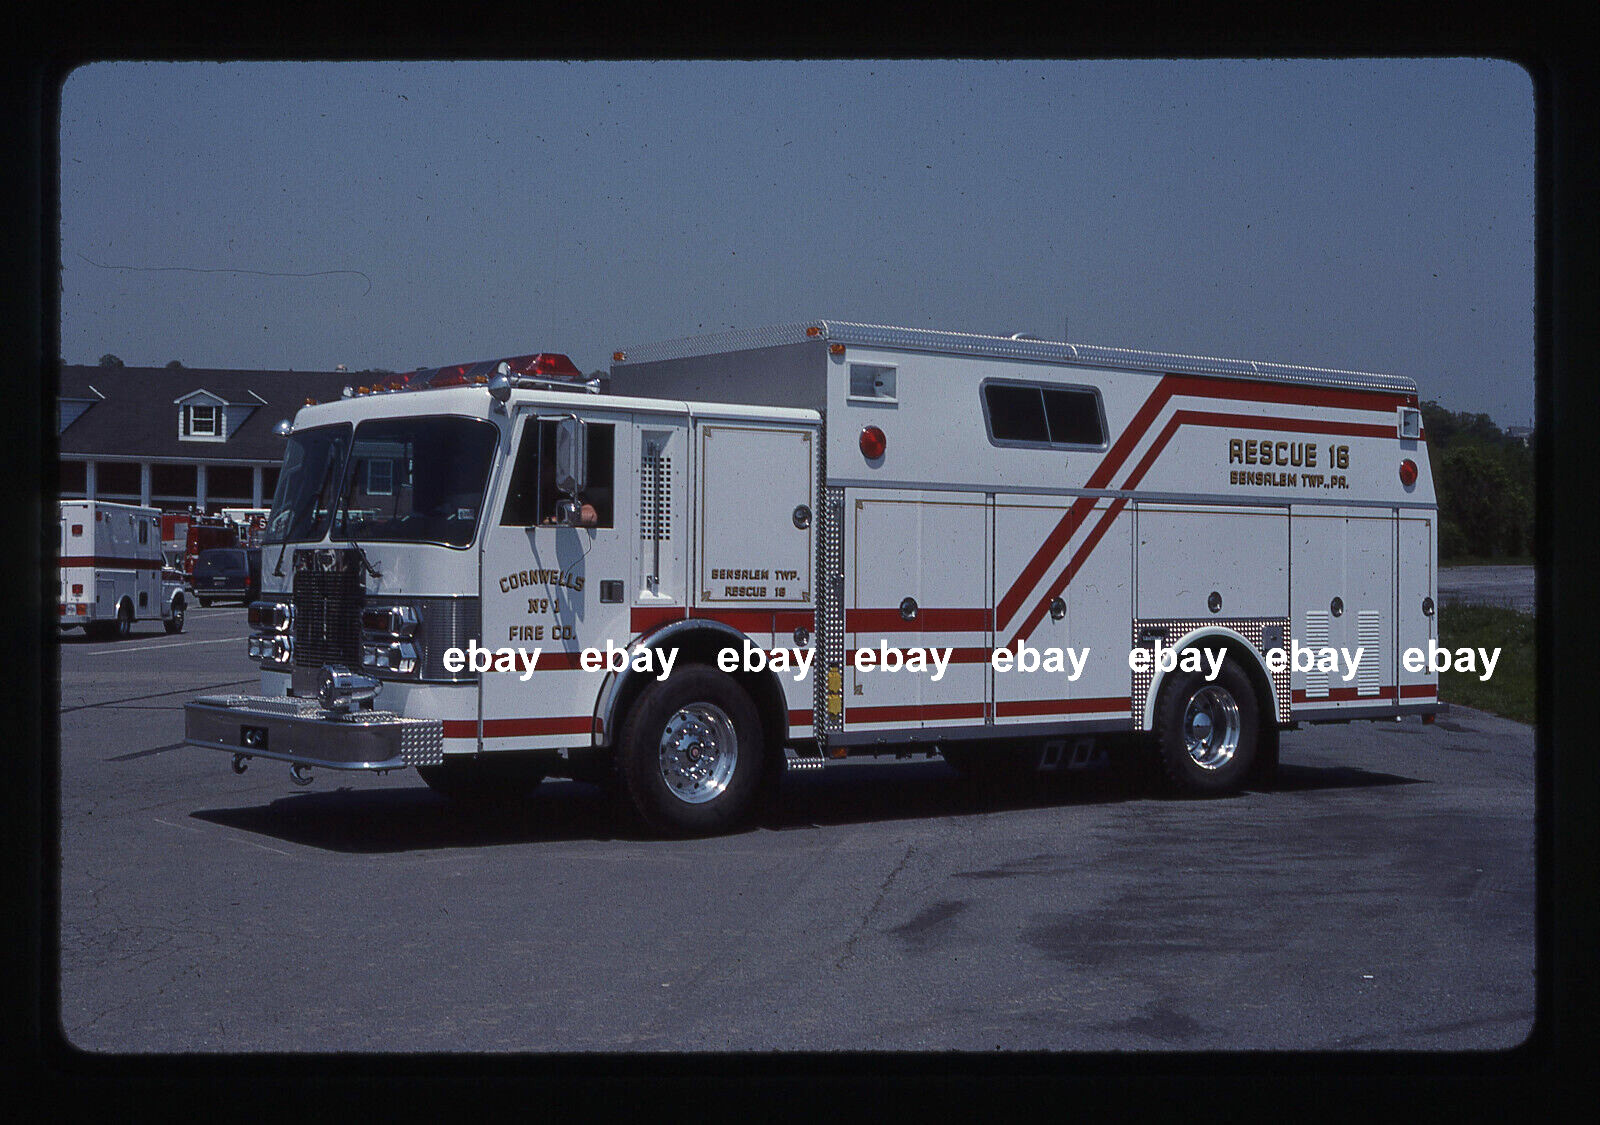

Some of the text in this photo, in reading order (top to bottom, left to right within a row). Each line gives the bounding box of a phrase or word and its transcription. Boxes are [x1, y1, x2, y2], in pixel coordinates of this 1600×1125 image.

[1229, 438, 1349, 469] RESCUE 16
[1230, 471, 1297, 487] BENSALEM
[499, 568, 585, 593] CORNWELLS
[711, 568, 800, 581] BENSALEM TWP.
[724, 585, 767, 597] RESCUE
[553, 598, 560, 613] 1
[509, 625, 576, 641] FIRE CO.
